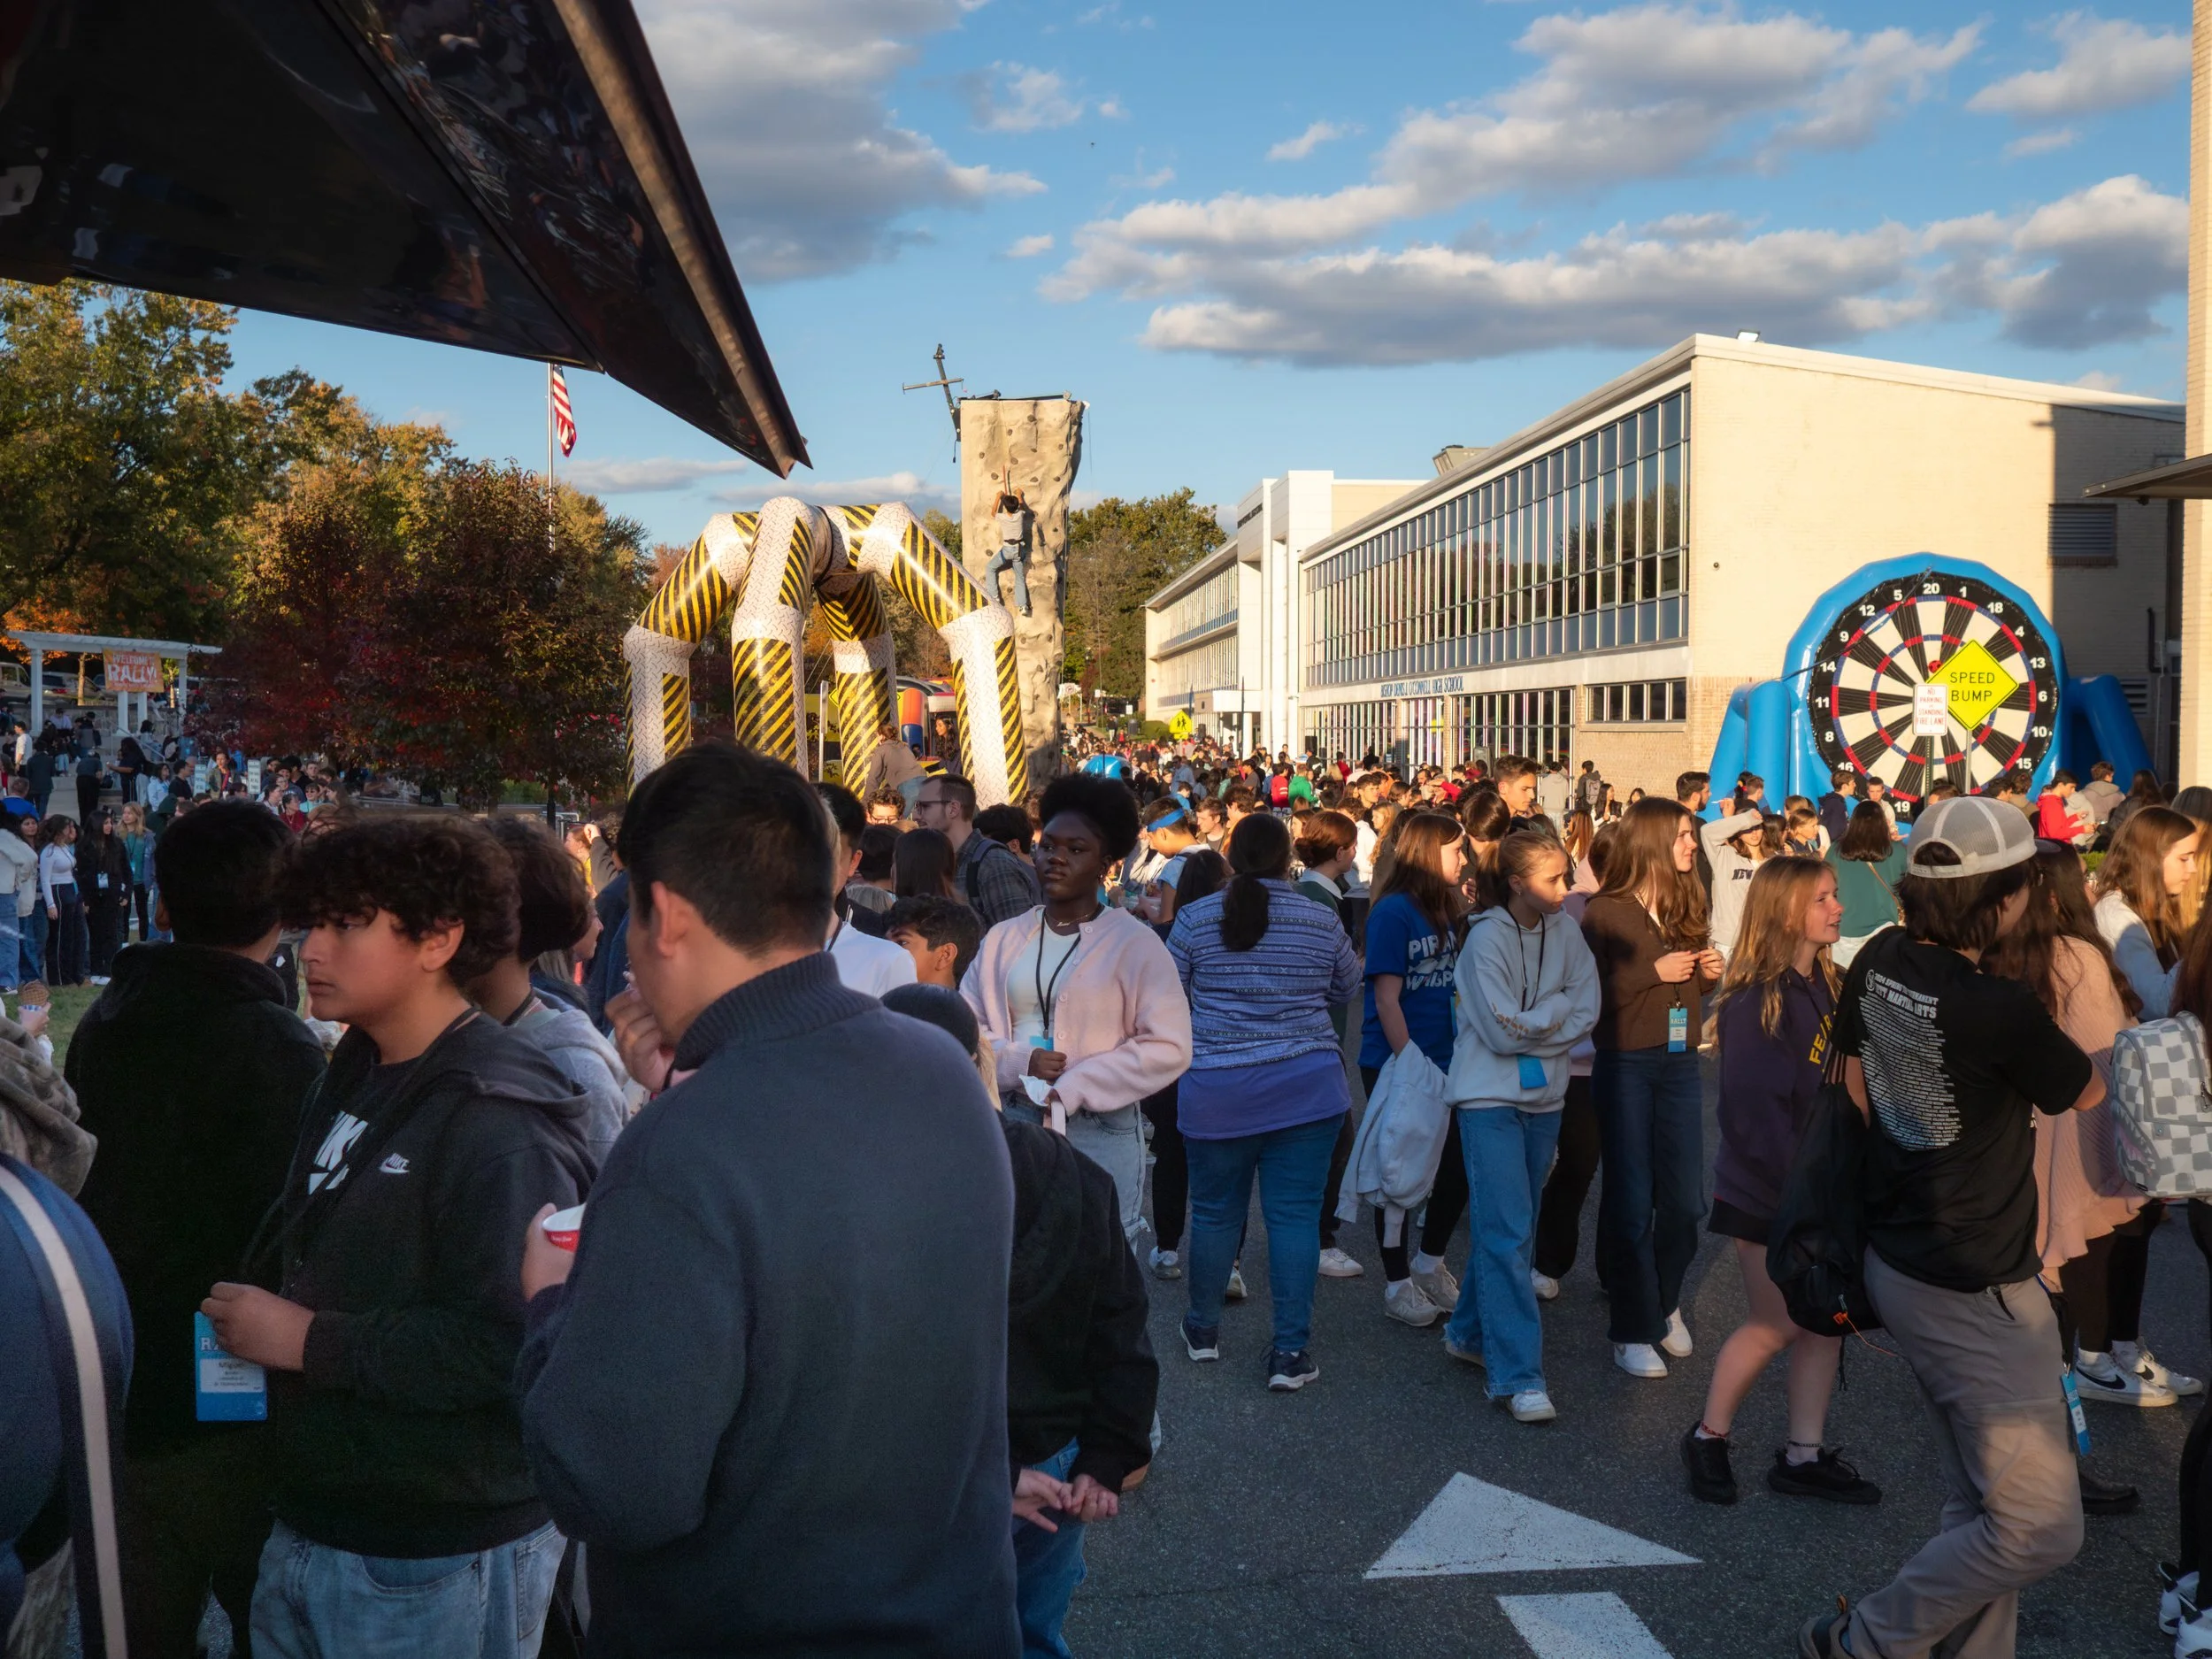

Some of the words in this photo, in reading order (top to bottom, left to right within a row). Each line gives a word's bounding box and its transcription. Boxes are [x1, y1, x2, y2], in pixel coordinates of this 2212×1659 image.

[1923, 583, 1940, 594] 20
[1959, 586, 1967, 597] 1
[1893, 589, 1902, 601] 5
[1859, 605, 1875, 616] 12
[1987, 603, 2003, 613] 18
[1839, 631, 1849, 642] 9
[2015, 626, 2024, 637] 4
[1820, 661, 1836, 672] 14
[2030, 657, 2046, 668] 13
[1950, 672, 1995, 683] SPEED
[1444, 676, 1464, 692] SCHOOL
[1951, 690, 1993, 701] BUMP
[2038, 691, 2047, 702] 6
[1816, 697, 1829, 708] 11
[1824, 731, 1834, 742] 8
[2032, 726, 2047, 737] 10
[1838, 762, 1854, 772] 16
[2016, 758, 2032, 769] 15
[1894, 801, 1910, 812] 19
